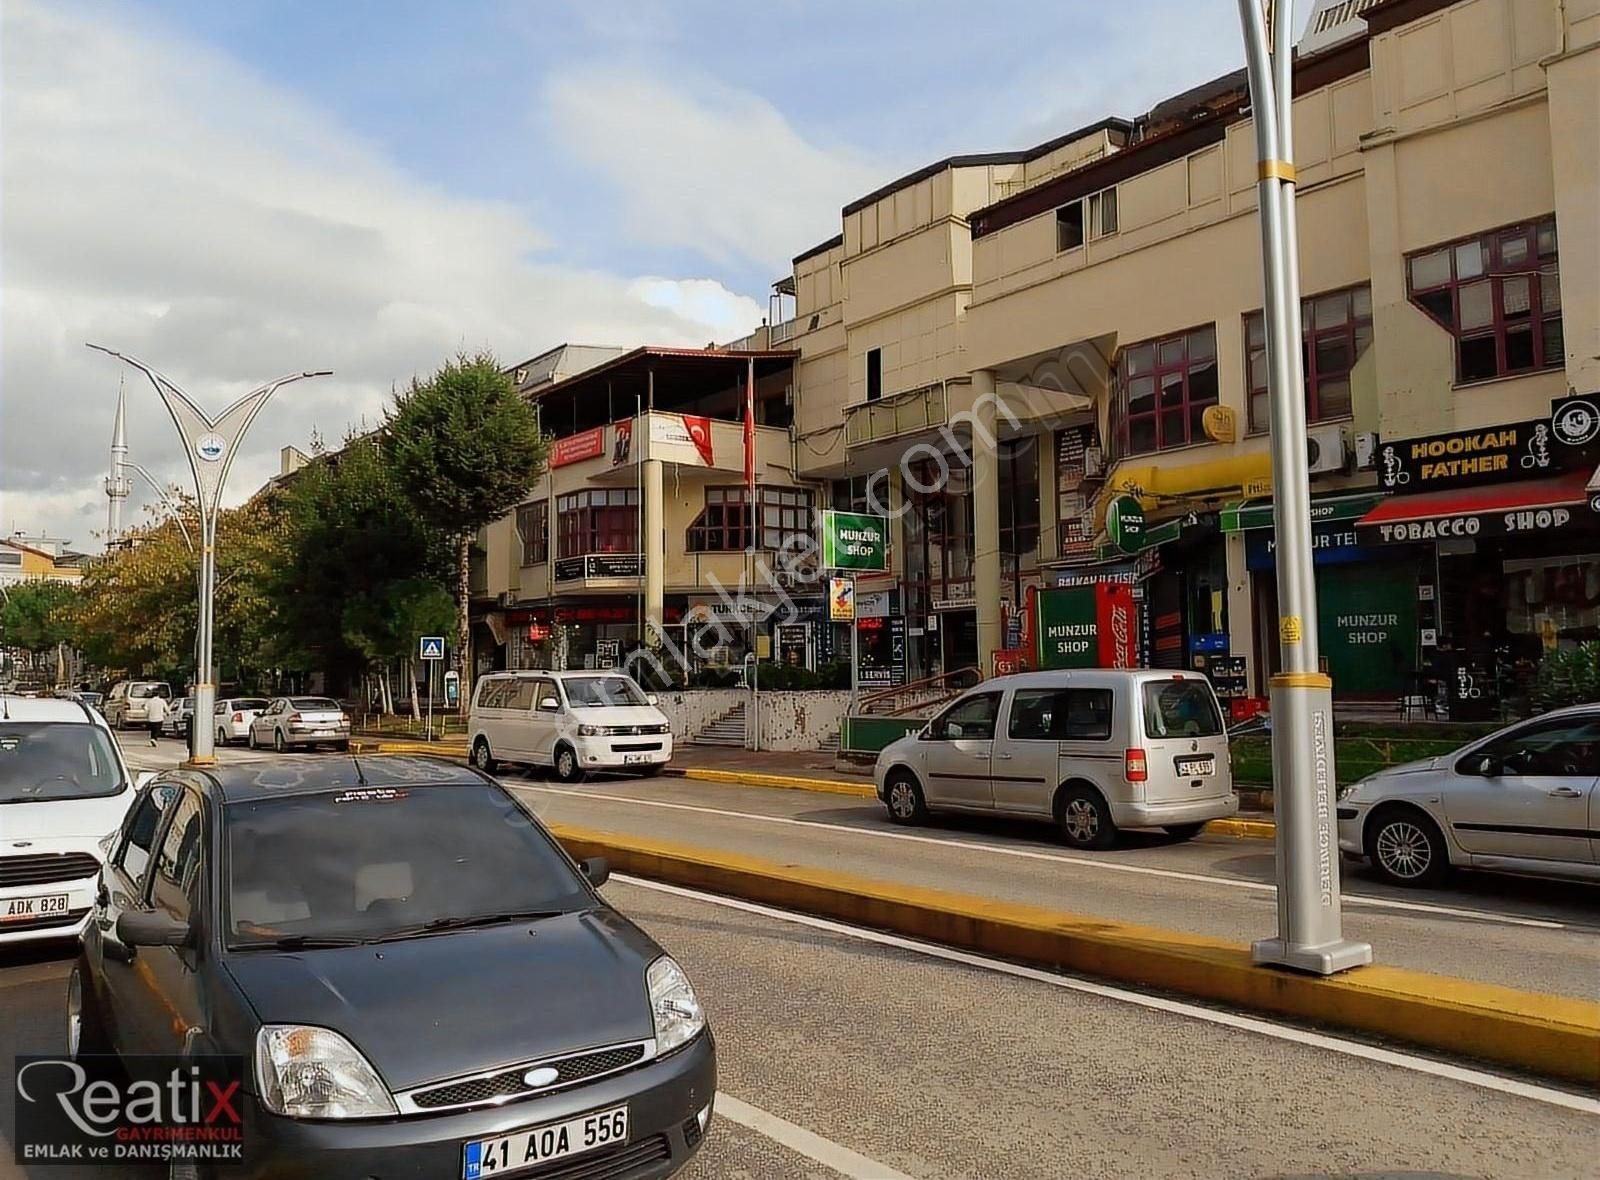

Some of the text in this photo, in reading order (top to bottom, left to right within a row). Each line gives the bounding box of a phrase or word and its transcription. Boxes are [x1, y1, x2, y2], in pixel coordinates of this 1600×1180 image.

[1411, 429, 1517, 459] HOOKAH
[1421, 454, 1509, 480] FATHER
[1310, 507, 1334, 517] SHOP
[1380, 509, 1570, 542] TOBACCO SHOP
[840, 529, 881, 543] MUNZUR
[847, 545, 874, 557] SHOP
[1338, 614, 1398, 628] MUNZUR
[1048, 624, 1098, 638] MUNZUR
[1348, 632, 1387, 644] SHOP
[1057, 641, 1089, 653] SHOP
[40, 897, 66, 912] 828
[482, 1139, 510, 1171] 41
[584, 1111, 626, 1147] 556
